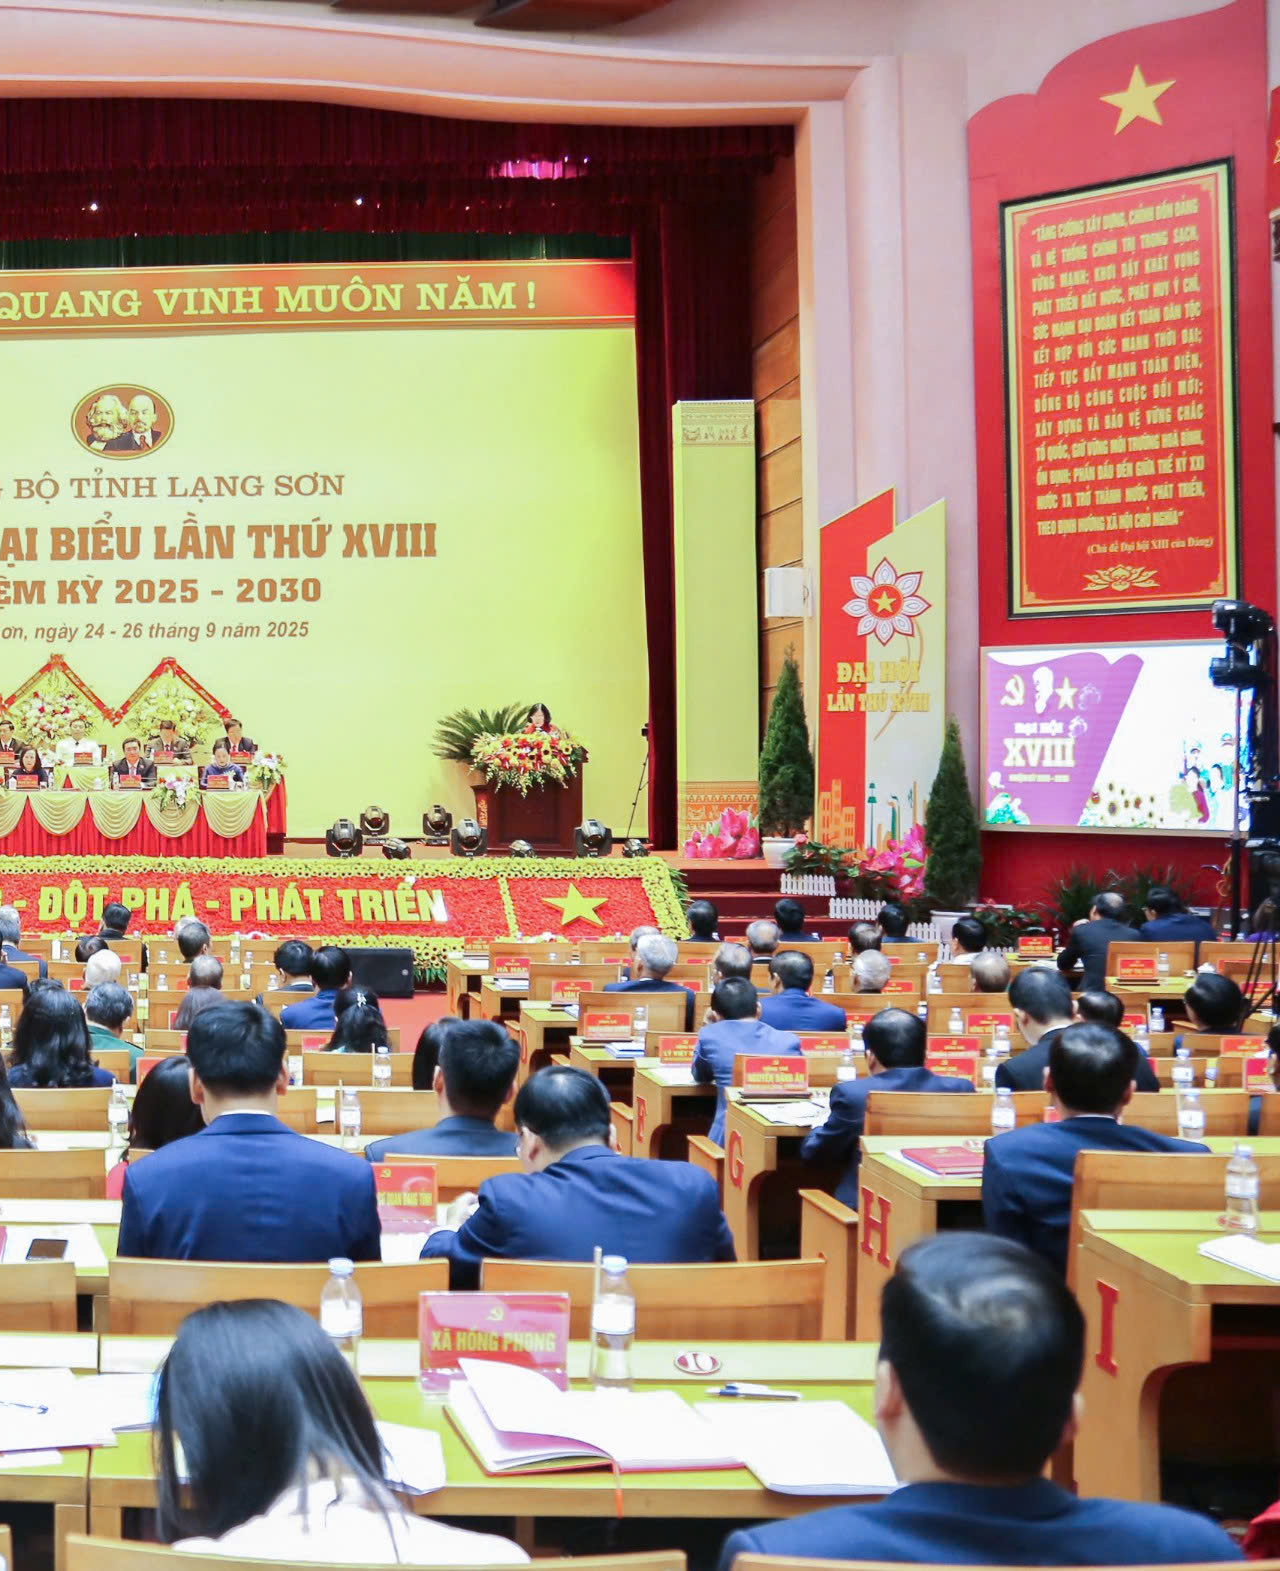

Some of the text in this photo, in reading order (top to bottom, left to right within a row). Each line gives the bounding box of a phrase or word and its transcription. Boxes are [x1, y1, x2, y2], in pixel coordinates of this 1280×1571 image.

[153, 287, 263, 315] VINH
[275, 275, 404, 312] MUÔN
[416, 275, 516, 310] NĂM
[14, 471, 59, 504] BỘ
[70, 468, 157, 498] TỈNH
[168, 475, 264, 503] LẠNG
[275, 472, 344, 496] SƠN
[50, 511, 141, 560] BIỂU
[154, 512, 235, 560] LẦN
[247, 517, 332, 559] THỨ
[343, 523, 436, 558] XVIII
[57, 575, 103, 604] KỲ
[115, 579, 198, 604] 2025
[237, 578, 321, 602] 2030
[35, 627, 78, 643] ngày
[85, 623, 104, 639] 24
[122, 623, 143, 638] 26
[149, 623, 200, 642] tháng
[206, 622, 216, 638] 9
[222, 623, 260, 638] năm
[267, 622, 309, 637] 2025
[837, 662, 874, 688] ĐẠI
[827, 686, 855, 712] LẦN
[1003, 738, 1075, 767] XVIII
[38, 880, 109, 928] ĐỘT
[123, 882, 195, 921] PHÁ
[230, 882, 323, 921] PHÁT
[337, 876, 448, 922] TRIỂN
[729, 1129, 745, 1189] G
[860, 1185, 892, 1269] H
[431, 1325, 557, 1352] XÃ HỒNG PHONG
[1095, 1279, 1119, 1378] I
